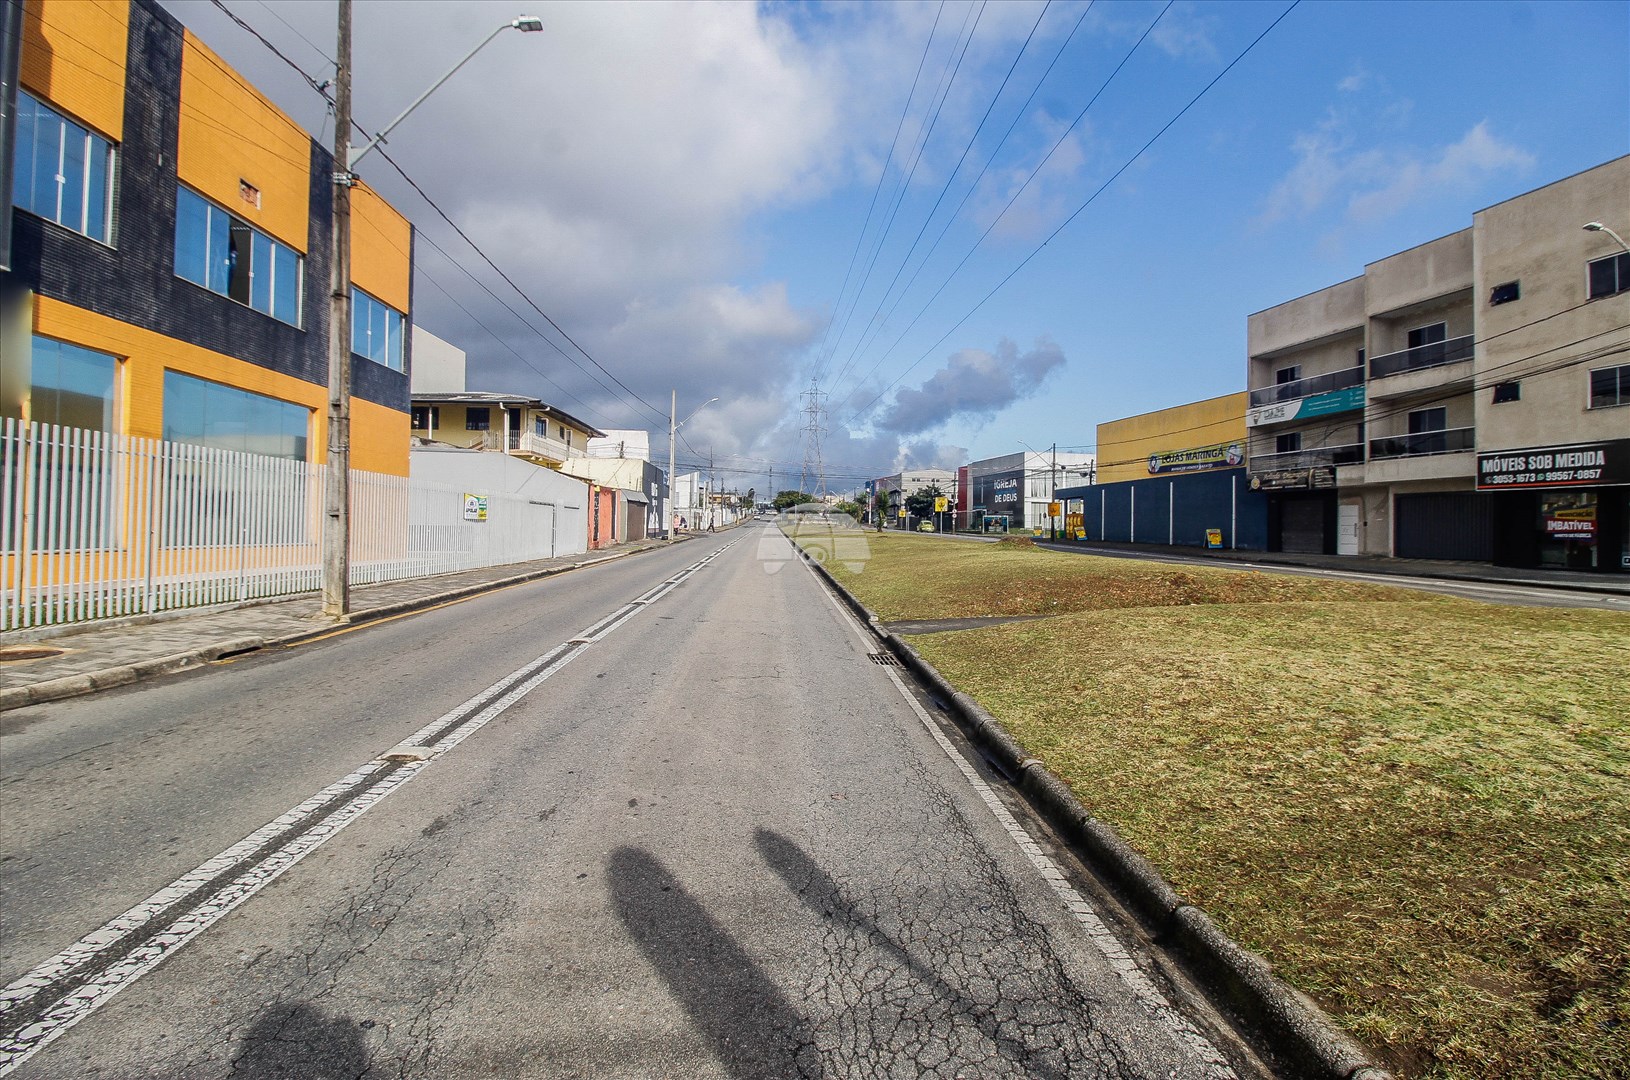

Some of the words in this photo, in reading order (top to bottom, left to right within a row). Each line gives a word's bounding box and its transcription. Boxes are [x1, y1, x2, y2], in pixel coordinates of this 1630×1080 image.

[1162, 452, 1184, 464] LOJAS
[1185, 446, 1224, 461] MARINGÁ
[1482, 456, 1526, 473] MÓVEIS
[1528, 455, 1553, 470] SOB
[1555, 450, 1605, 468] MEDIDA
[1492, 473, 1536, 484] 3053-1673
[1545, 469, 1602, 481] 99567-0857
[994, 479, 1017, 489] IGREJA
[995, 495, 1002, 503] DE
[1003, 493, 1017, 502] DEUS
[1547, 520, 1595, 531] IMBATÍVEL
